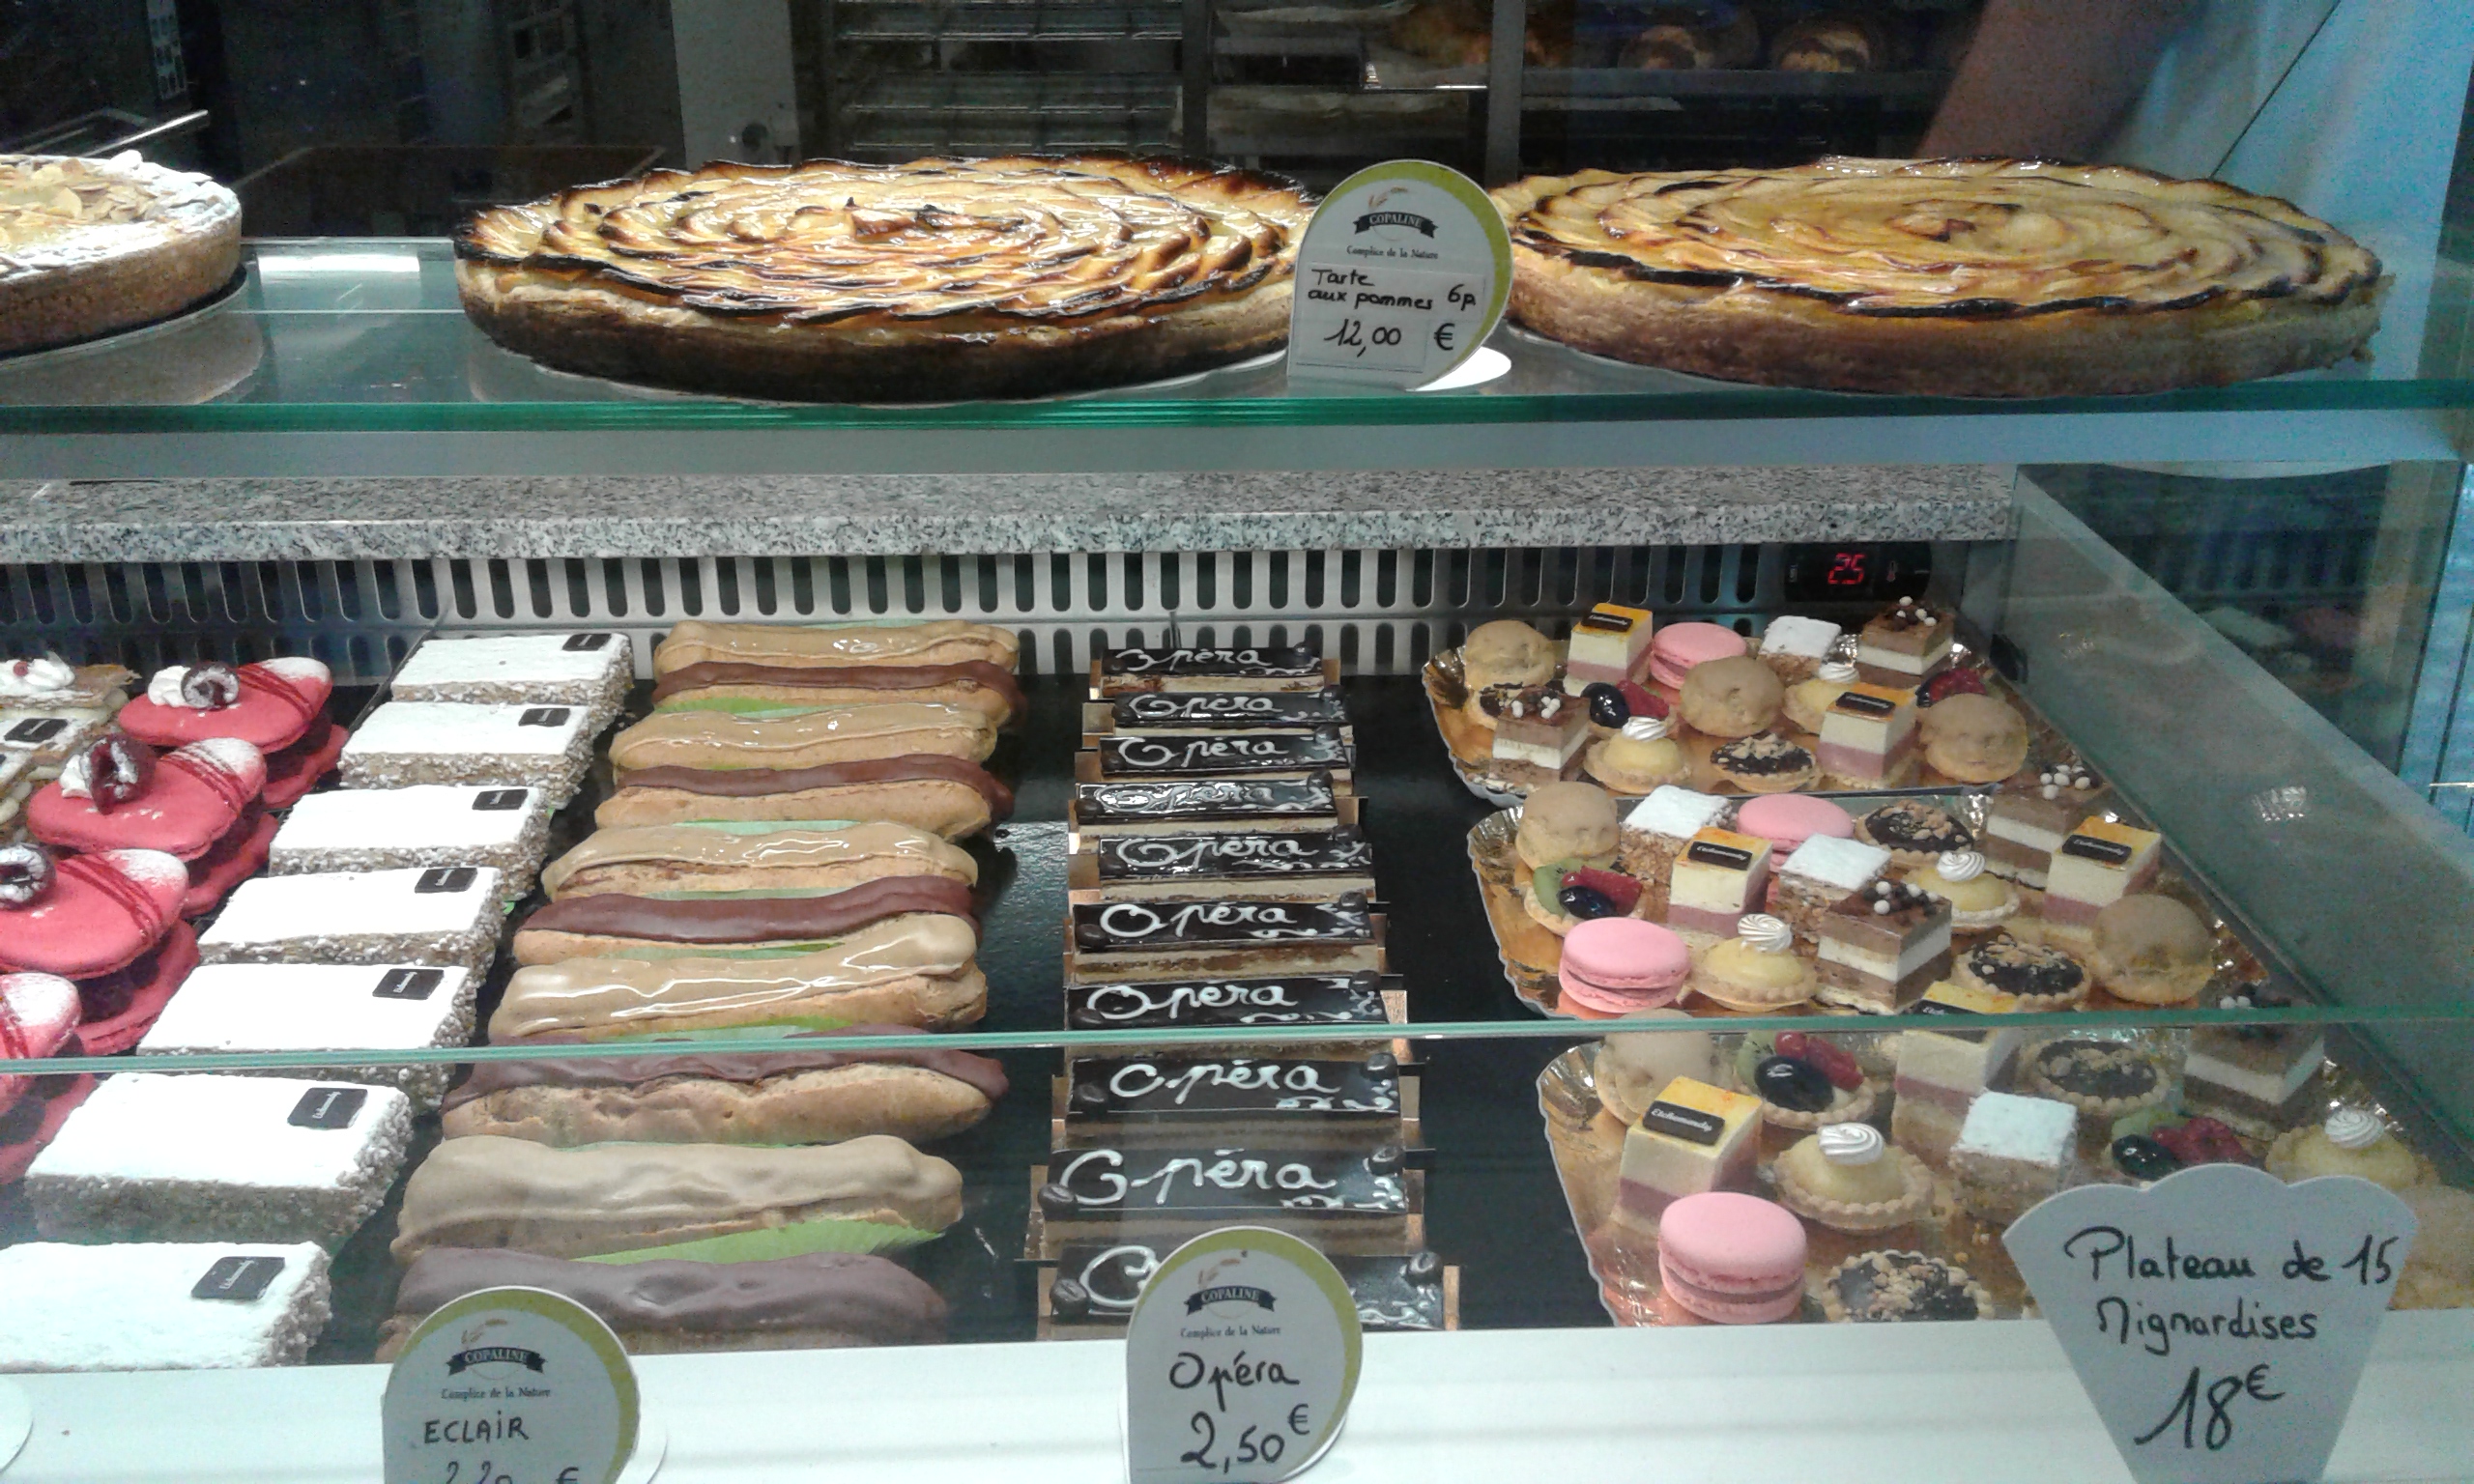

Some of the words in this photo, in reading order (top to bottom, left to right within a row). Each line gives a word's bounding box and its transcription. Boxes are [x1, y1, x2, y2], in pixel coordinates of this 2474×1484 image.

[1368, 213, 1424, 228] COPALINE
[1346, 245, 1384, 259] Complice
[1387, 247, 1396, 258] de
[1399, 247, 1409, 258] la
[1412, 248, 1439, 259] Nature
[1311, 269, 1375, 286] Tarte
[1308, 290, 1347, 302] aux
[1354, 291, 1433, 310] pommes
[1324, 318, 1401, 357] 12,00
[1434, 323, 1455, 351] €
[1827, 552, 1868, 585] 25
[2063, 1226, 2256, 1281] Plateau
[2283, 1240, 2331, 1281] de
[2342, 1235, 2400, 1285] 15
[1199, 1288, 1260, 1302] COPALINE
[1224, 1326, 1235, 1337] de
[1240, 1326, 1248, 1336] la
[1251, 1325, 1281, 1335] Nature
[464, 1349, 528, 1363] COPALINE
[1168, 1350, 1300, 1413] Opéra
[505, 1386, 514, 1398] la
